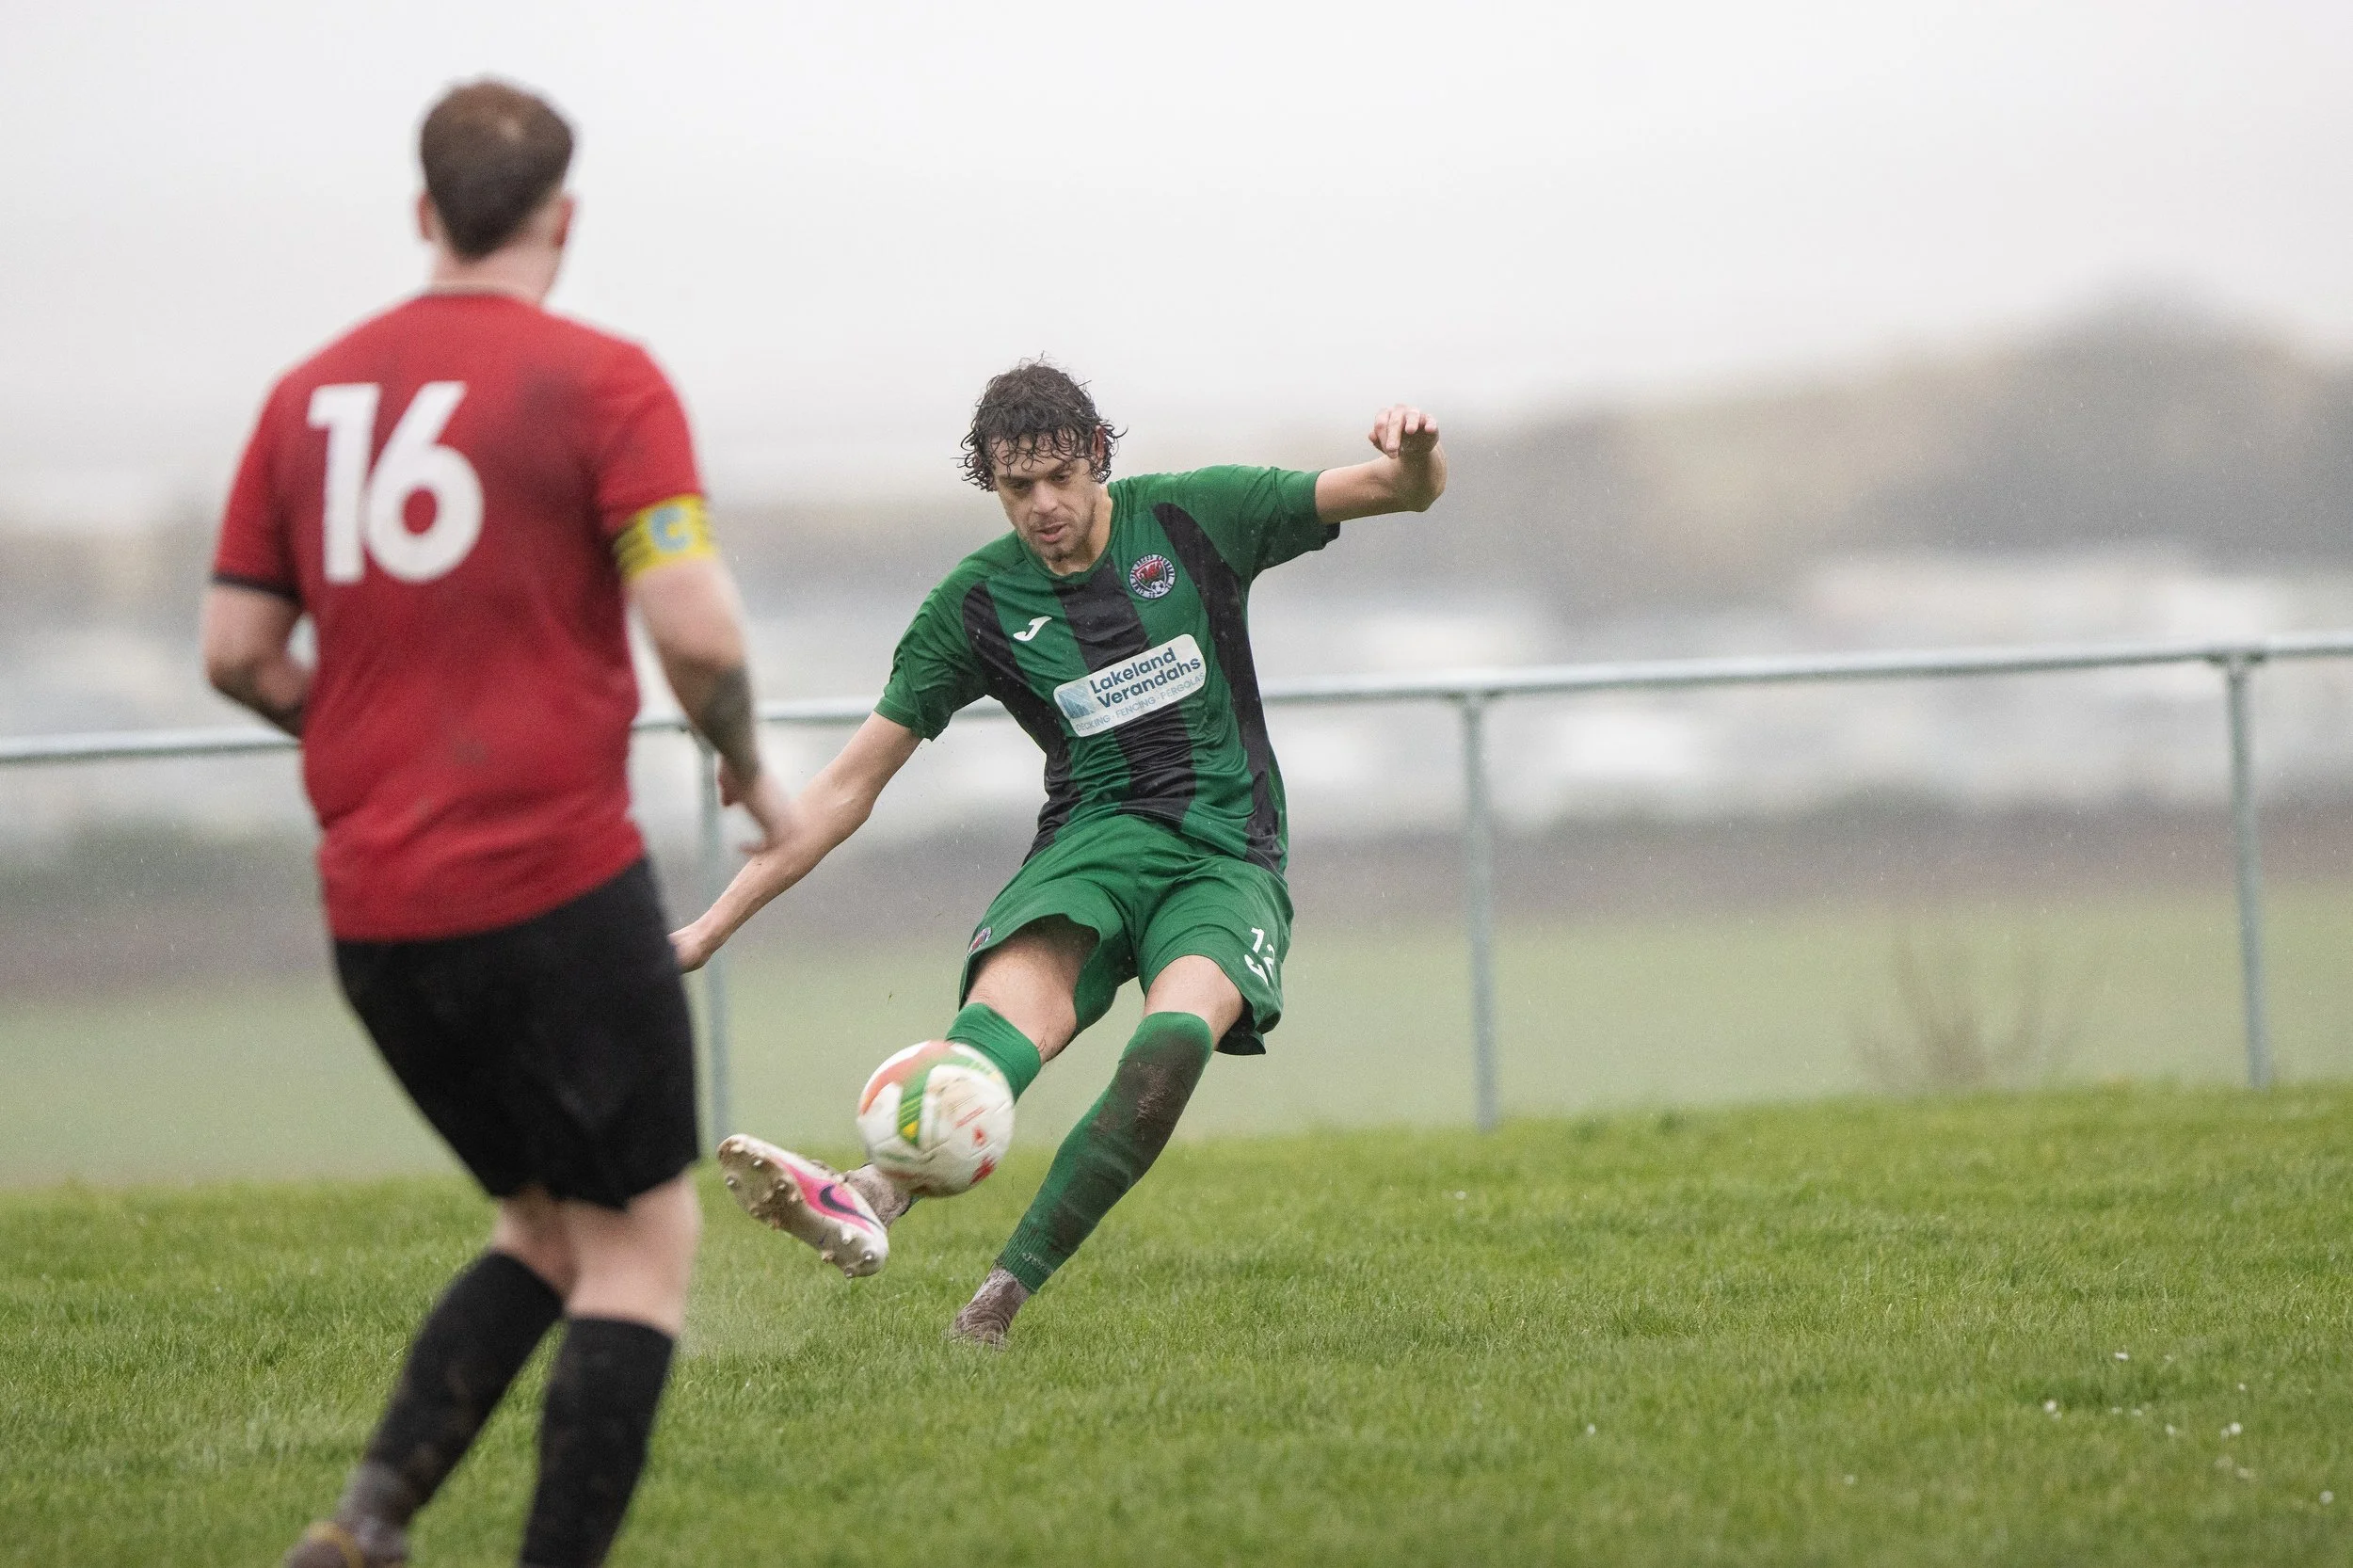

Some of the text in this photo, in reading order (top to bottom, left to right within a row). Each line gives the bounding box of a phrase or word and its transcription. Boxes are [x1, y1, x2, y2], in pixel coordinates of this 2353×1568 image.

[308, 381, 486, 583] 16
[651, 505, 689, 551] C
[1089, 647, 1176, 694] Lakeland
[1096, 657, 1201, 708] Verandahs
[1076, 672, 1205, 731] DECKING FENCING PERGOLAS
